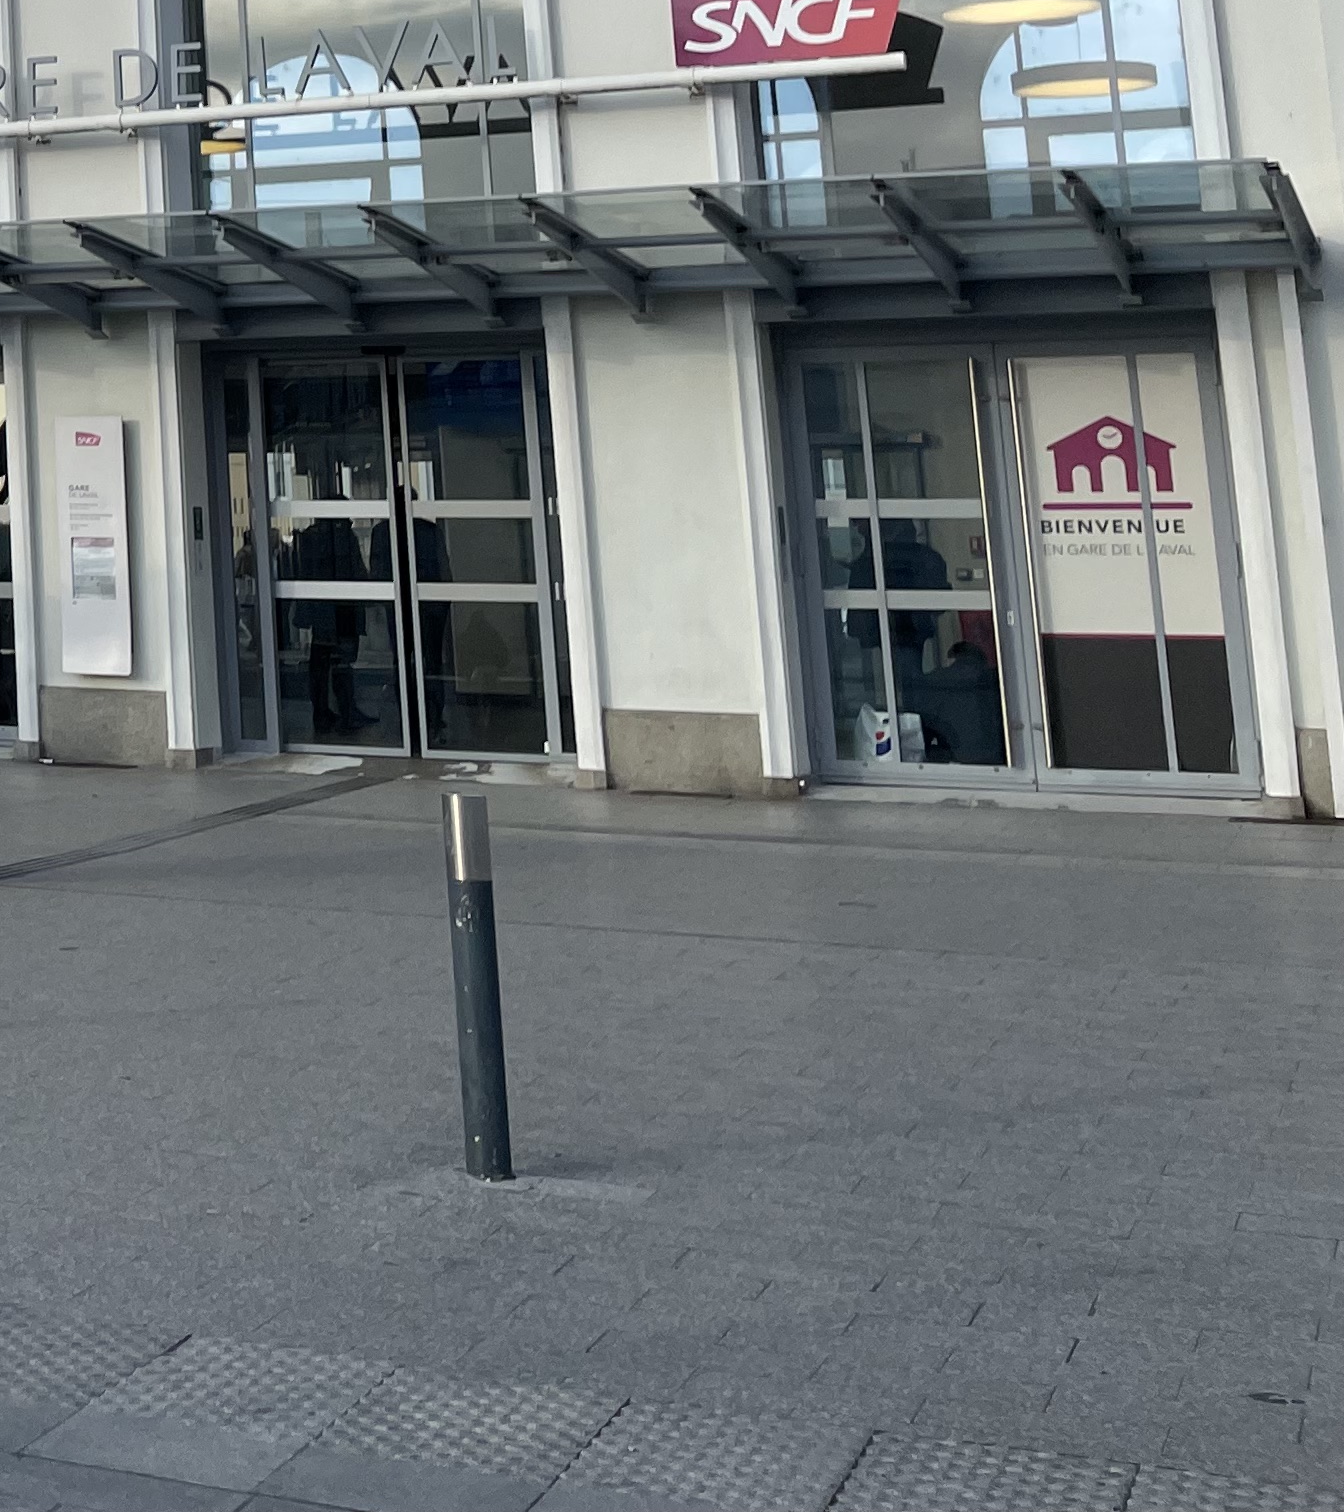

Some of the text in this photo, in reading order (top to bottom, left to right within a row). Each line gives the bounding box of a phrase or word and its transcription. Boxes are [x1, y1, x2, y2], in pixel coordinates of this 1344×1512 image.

[112, 42, 206, 108] DE
[260, 14, 520, 100] LAVAL
[1041, 518, 1186, 534] BIENVENUE
[1043, 543, 1196, 556] EN GARE DE LAVAL
